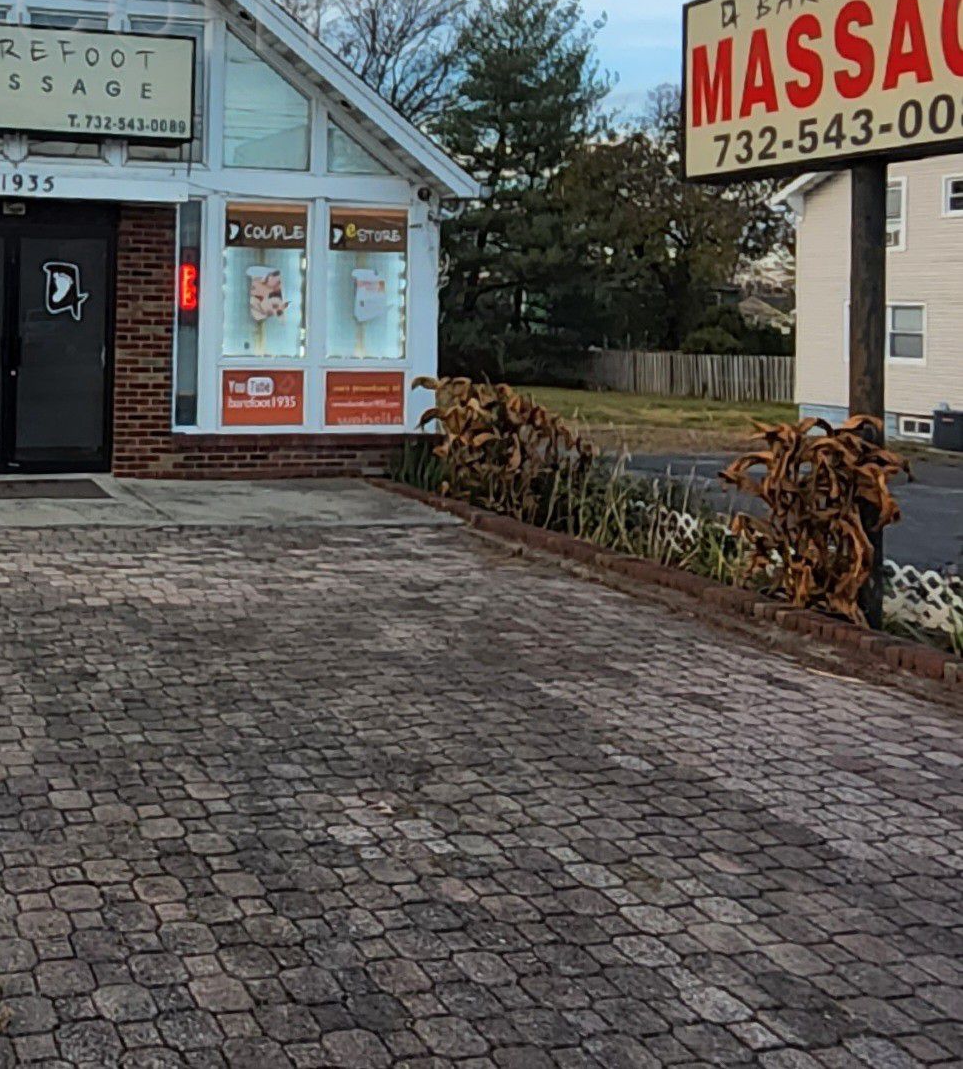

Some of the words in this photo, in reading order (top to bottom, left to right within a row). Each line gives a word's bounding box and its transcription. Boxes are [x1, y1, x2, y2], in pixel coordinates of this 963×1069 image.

[713, 93, 963, 167] 732-543-00
[1, 173, 55, 193] 1935
[244, 223, 304, 240] COUPLE
